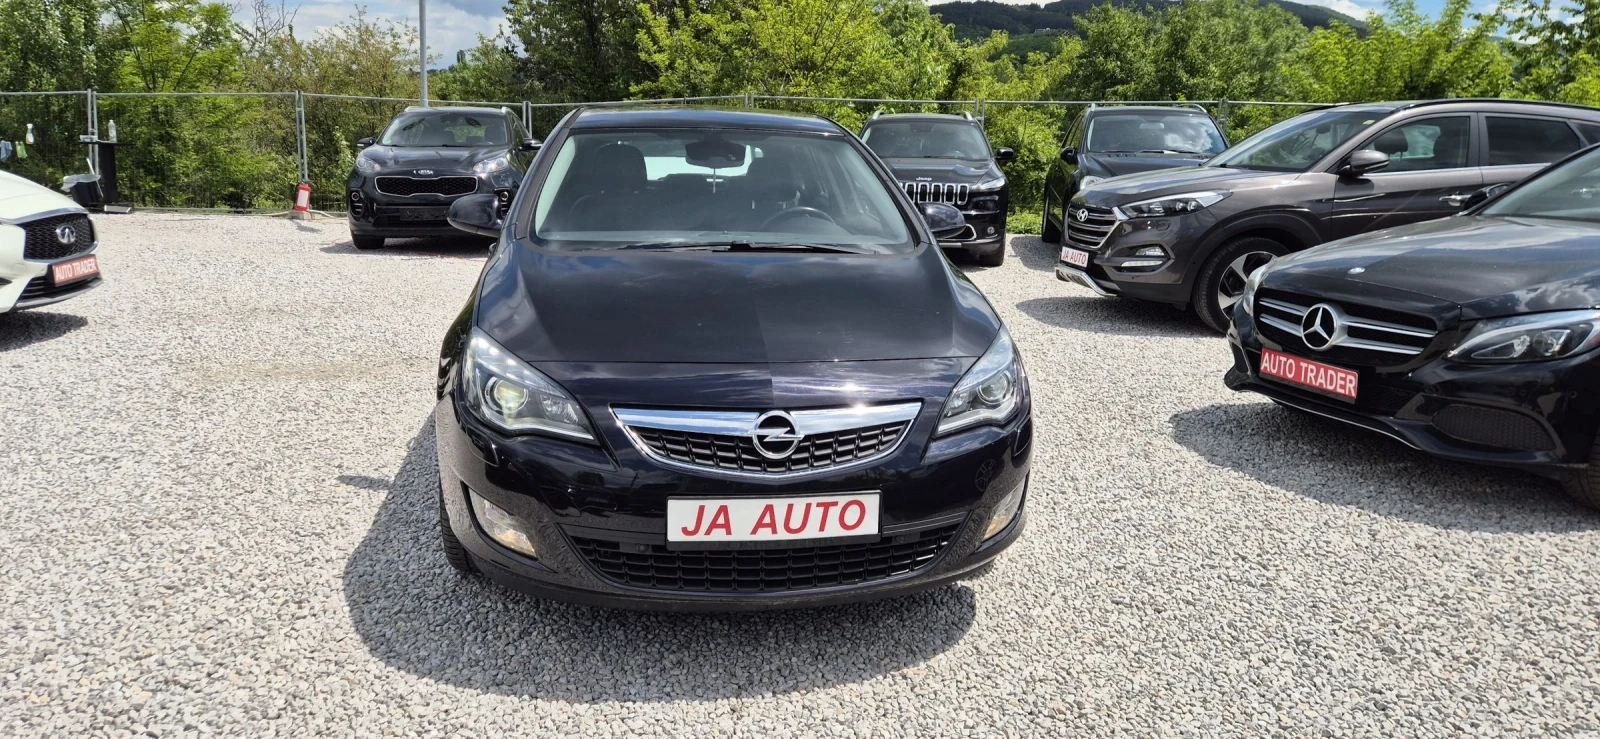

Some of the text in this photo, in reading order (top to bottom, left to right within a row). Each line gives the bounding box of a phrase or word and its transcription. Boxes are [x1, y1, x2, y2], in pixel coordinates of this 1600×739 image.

[55, 258, 97, 281] AUTO TRADER
[1063, 250, 1086, 264] JA AUTO
[1261, 352, 1355, 397] AUTO TRADER
[681, 499, 866, 536] JA AUTO
